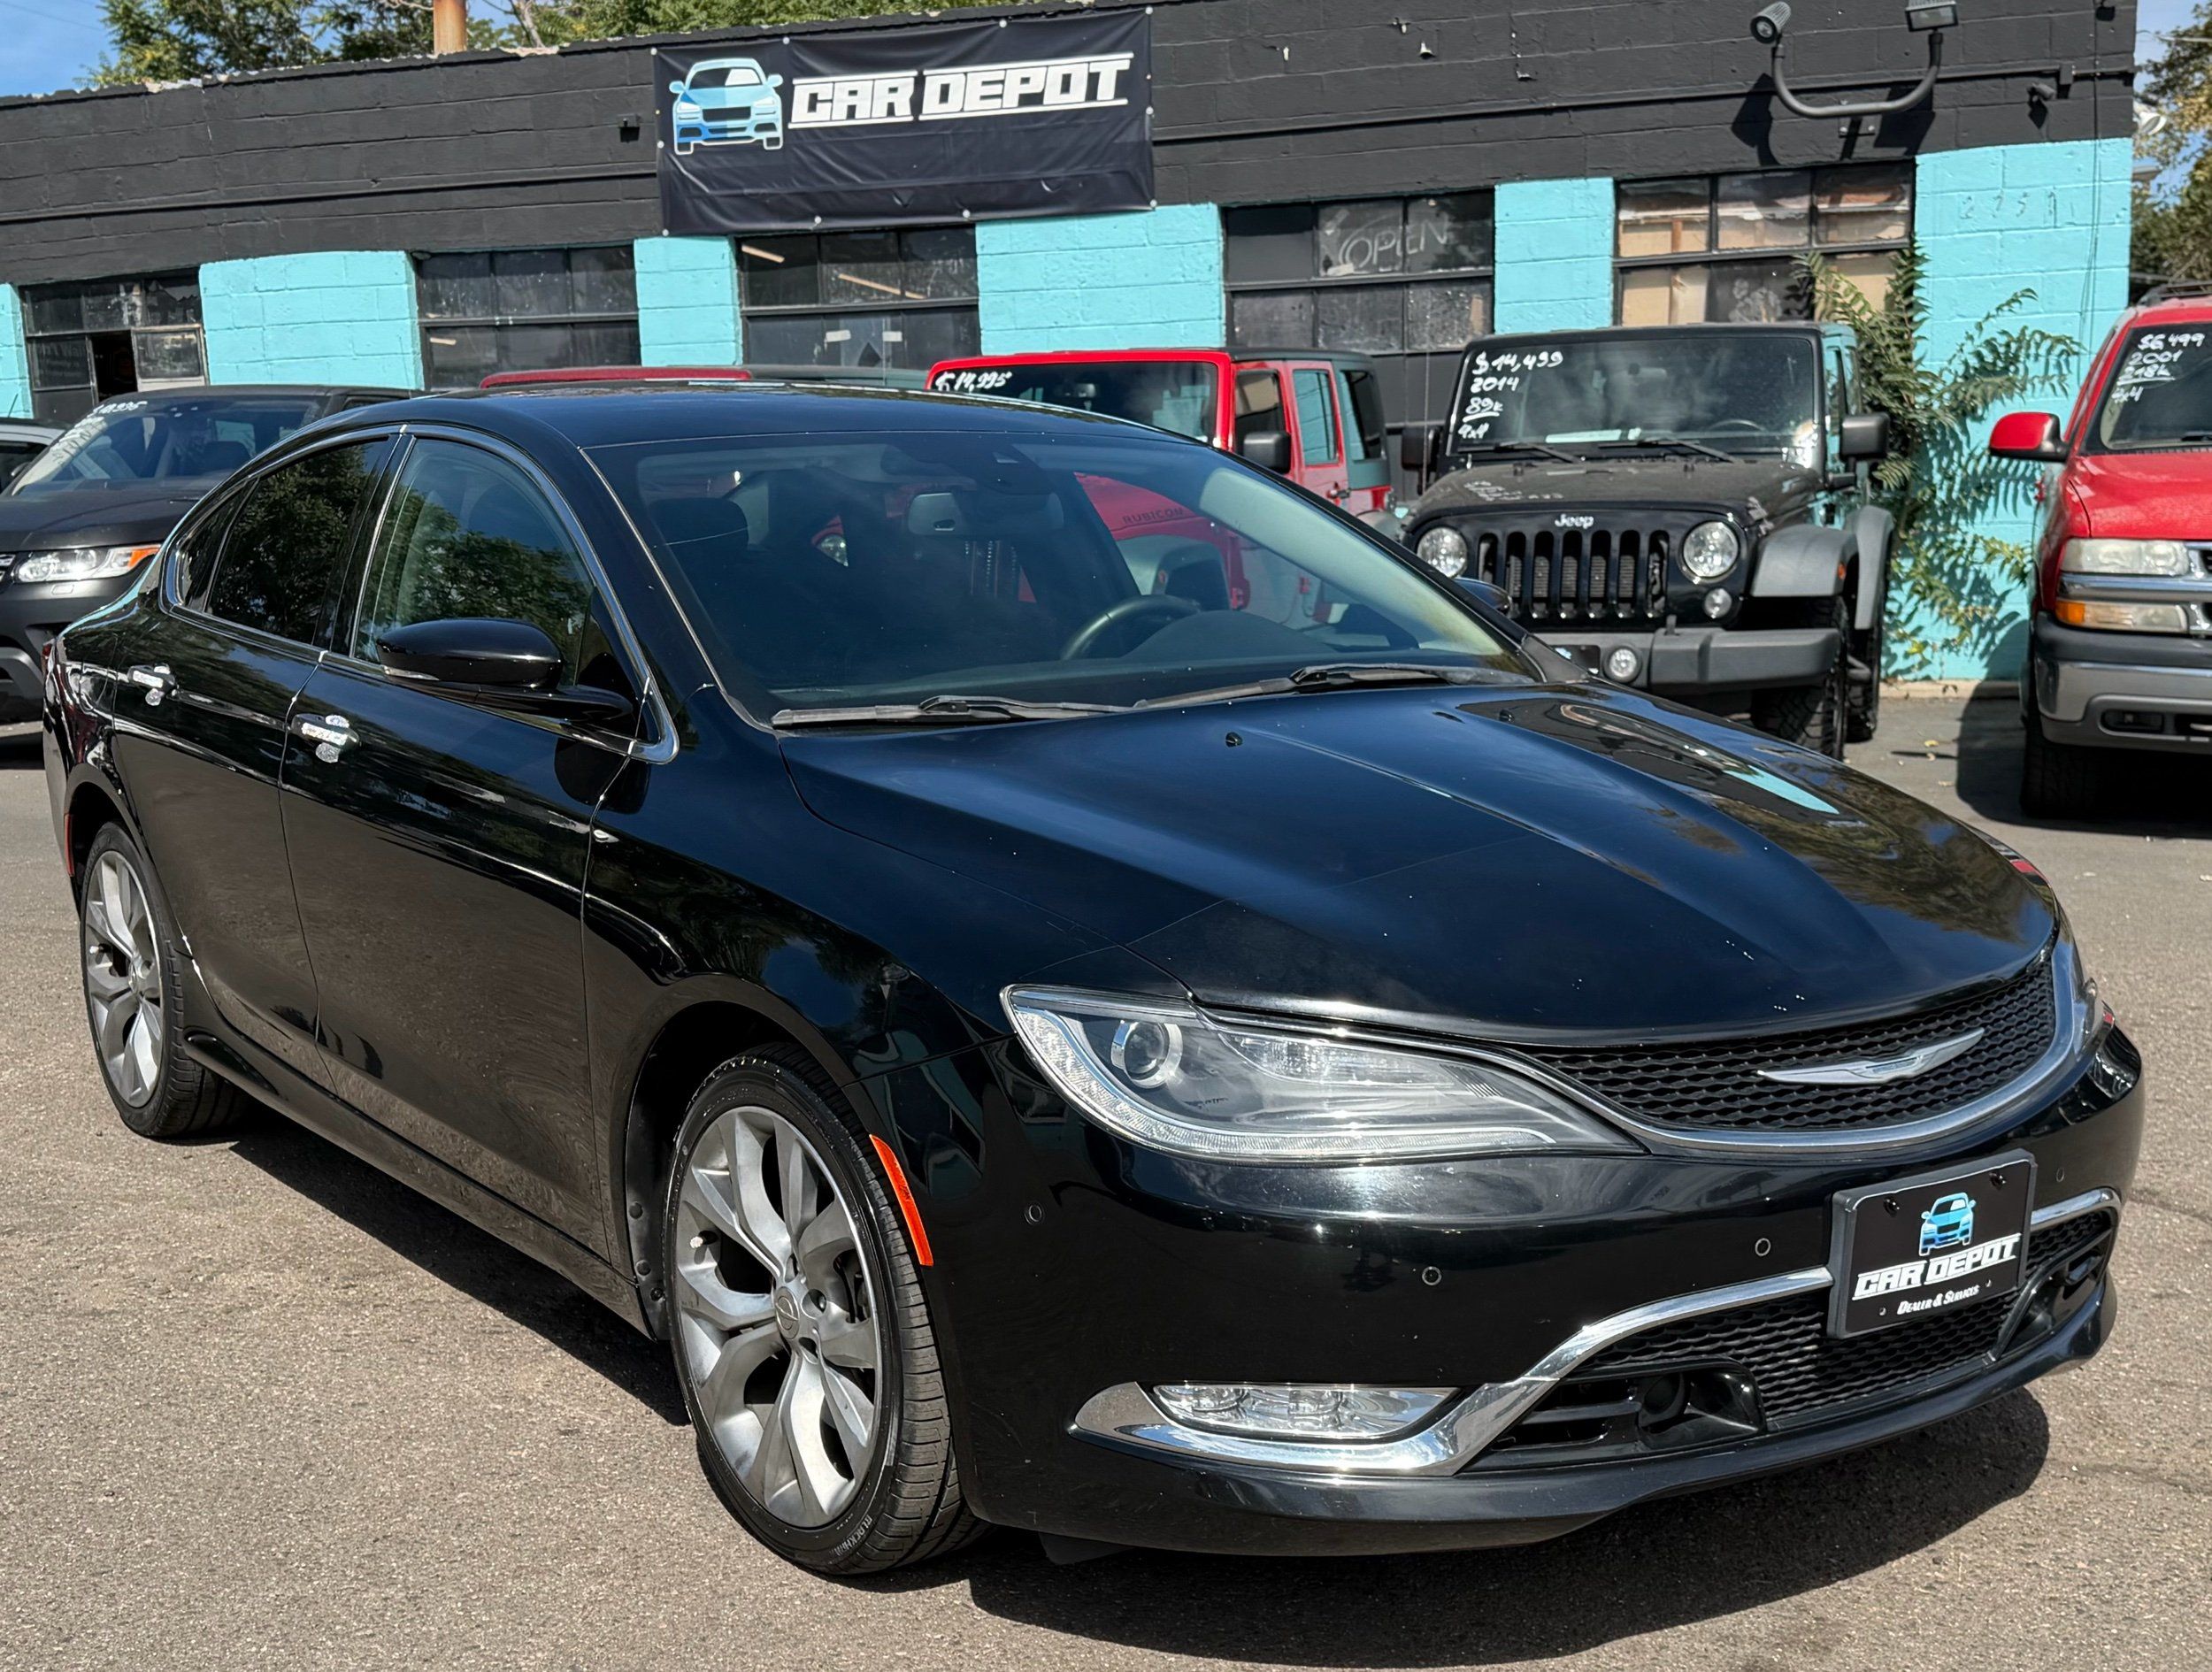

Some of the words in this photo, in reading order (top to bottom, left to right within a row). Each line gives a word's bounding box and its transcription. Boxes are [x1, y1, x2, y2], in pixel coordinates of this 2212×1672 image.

[792, 76, 917, 124] CAR
[921, 58, 1132, 115] DEPOT
[1339, 218, 1449, 268] OPEN
[2129, 349, 2183, 365] 2001
[1471, 377, 1519, 393] 2014
[1122, 508, 1183, 524] RUBICON
[1555, 513, 1594, 529] Jeep
[1853, 1262, 1927, 1300] CAR
[1925, 1235, 2021, 1284] DEPOT
